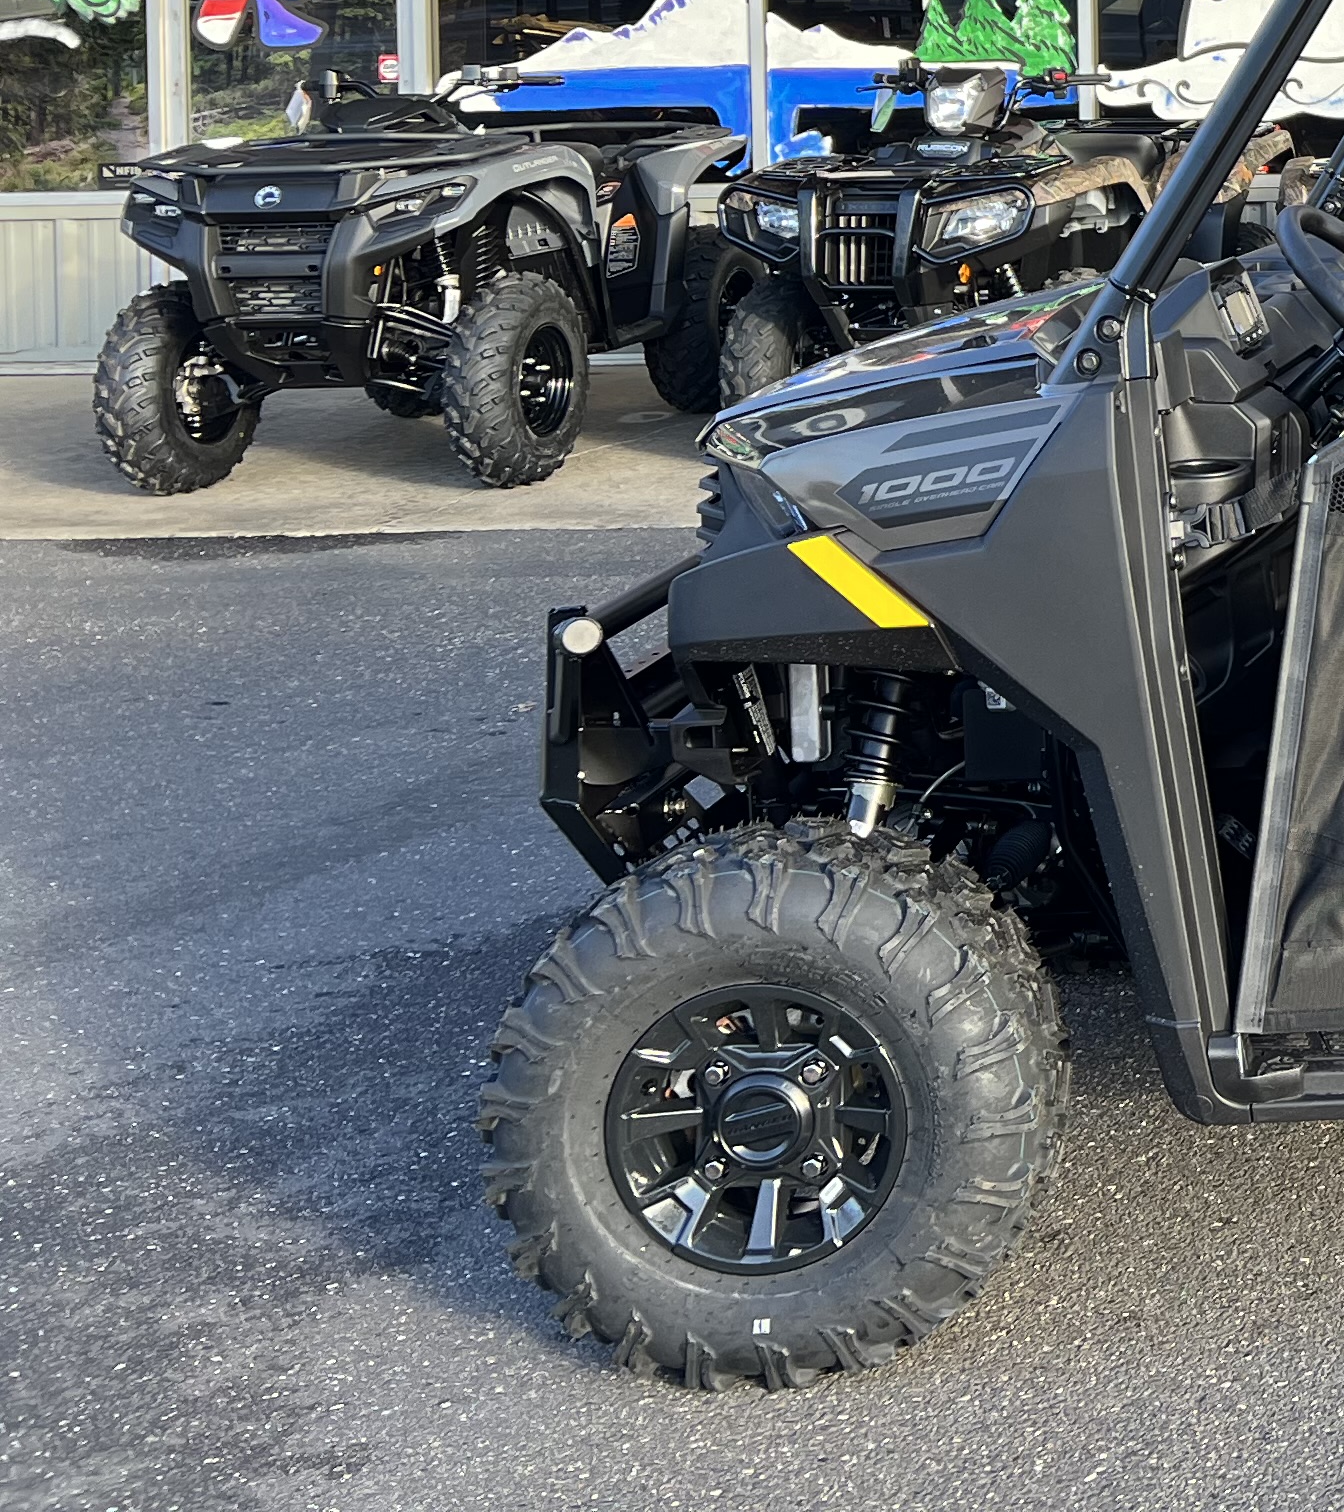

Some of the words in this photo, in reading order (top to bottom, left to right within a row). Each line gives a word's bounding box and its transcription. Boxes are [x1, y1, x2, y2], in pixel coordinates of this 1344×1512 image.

[858, 457, 1016, 505] 1000
[868, 499, 911, 512] SINGLE
[914, 486, 977, 504] OVERHEAD
[978, 481, 1006, 491] CAM
